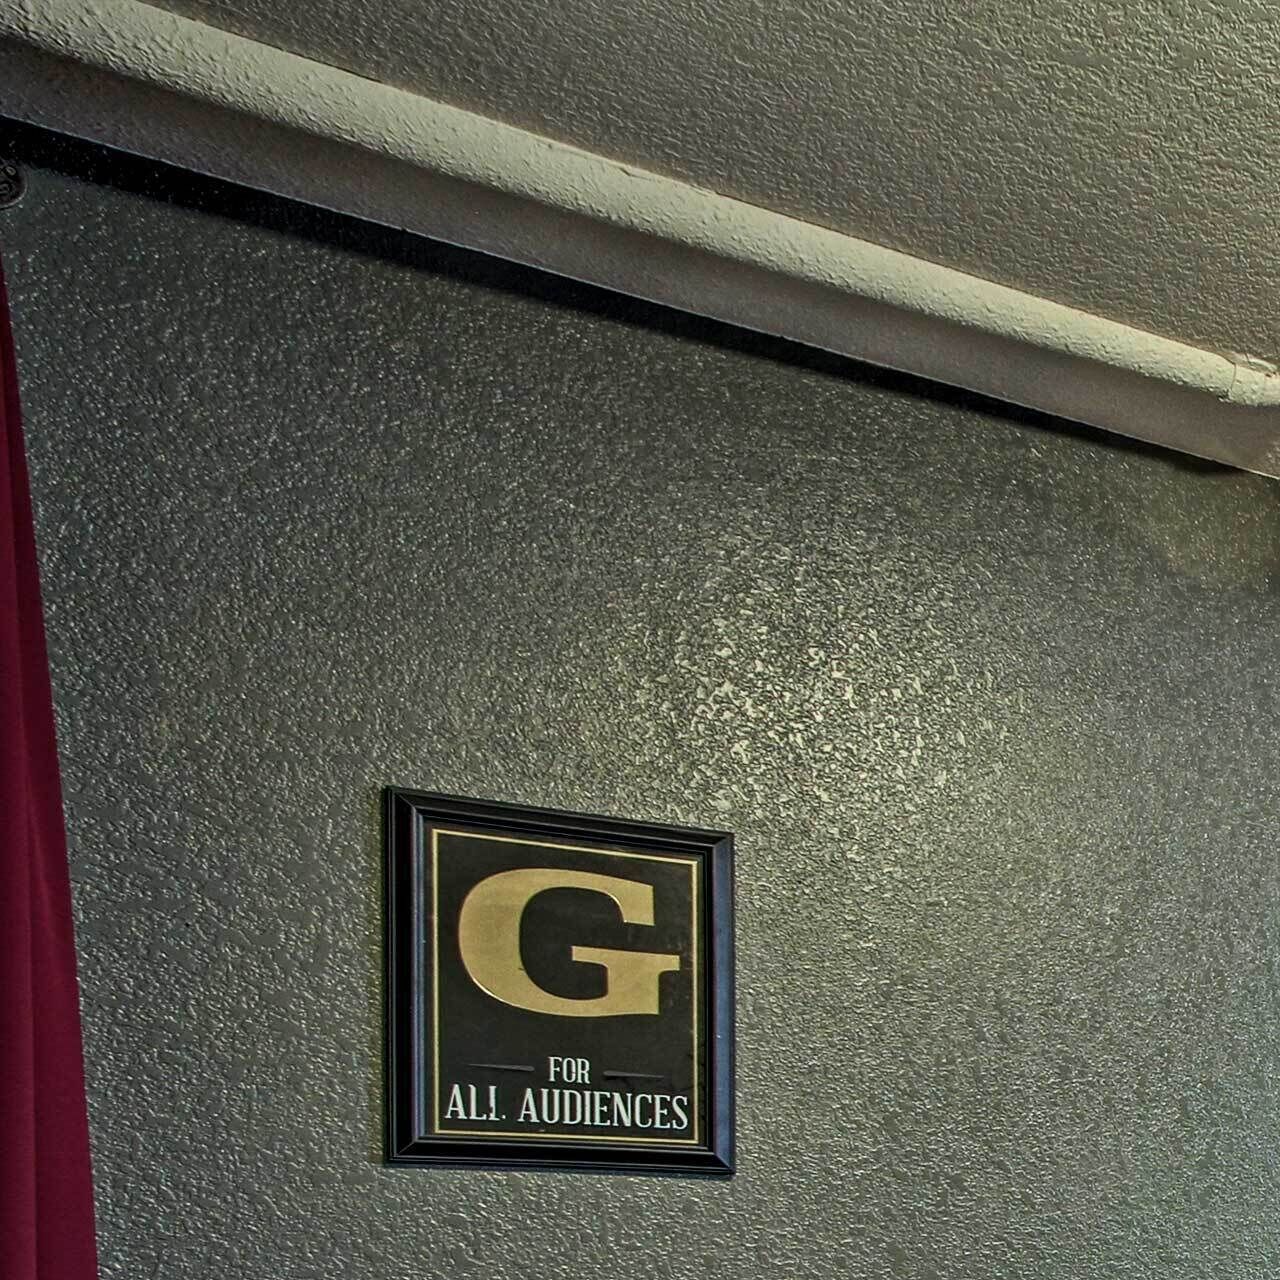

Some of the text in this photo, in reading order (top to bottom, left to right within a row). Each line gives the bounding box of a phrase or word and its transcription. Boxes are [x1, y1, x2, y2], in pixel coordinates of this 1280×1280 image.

[458, 867, 681, 1018] G
[548, 1056, 591, 1085] FOR
[517, 1087, 689, 1131] AUDIENCES
